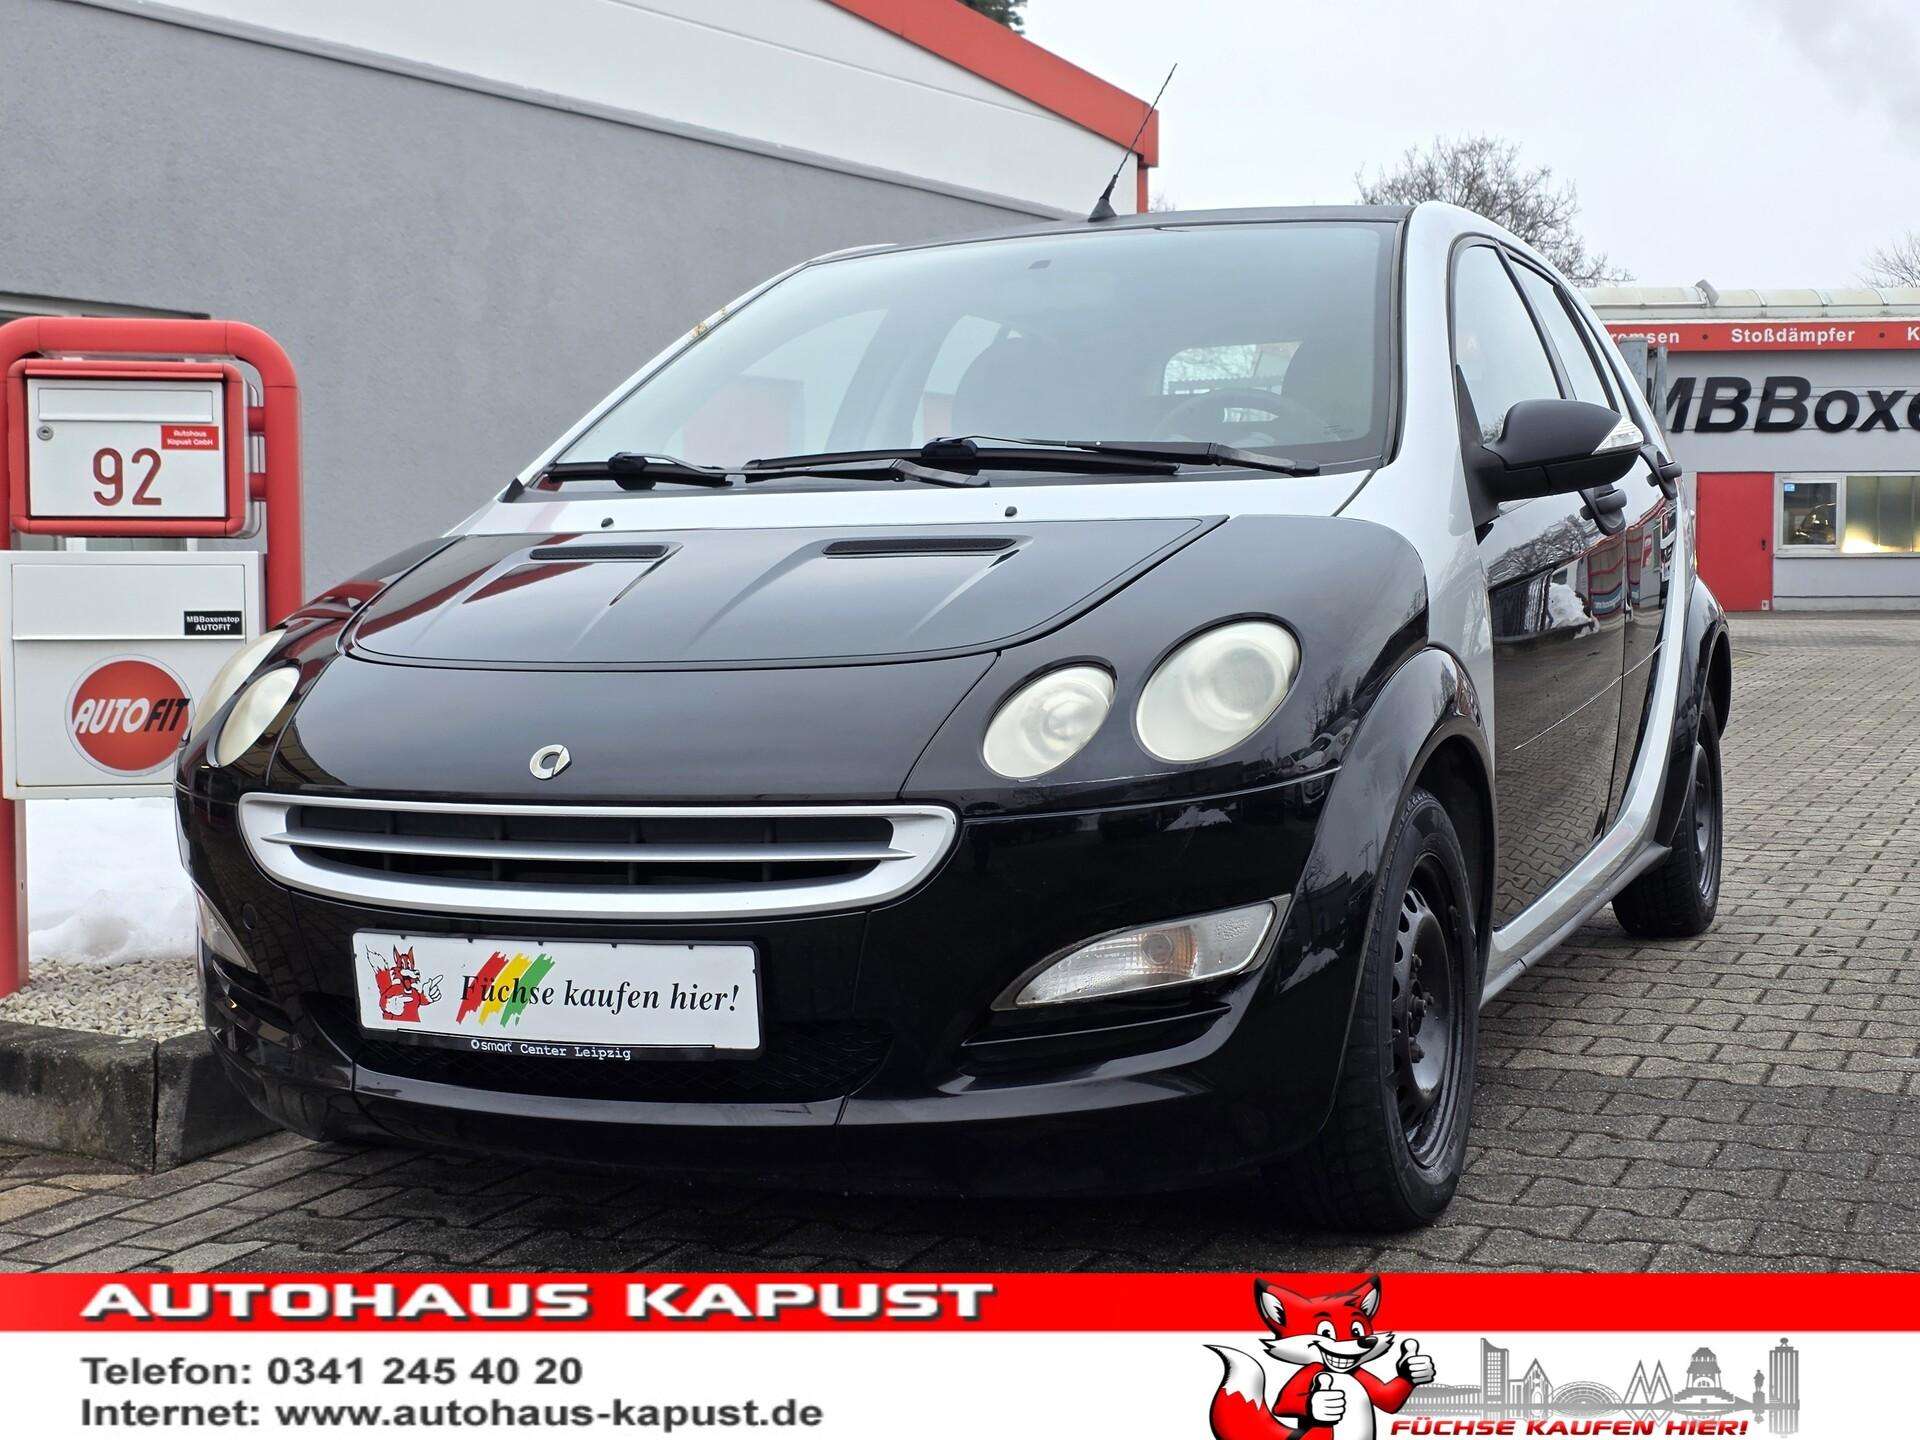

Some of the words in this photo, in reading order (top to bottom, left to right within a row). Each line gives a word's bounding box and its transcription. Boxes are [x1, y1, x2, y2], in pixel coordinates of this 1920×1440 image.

[1731, 327, 1856, 344] Stoßdämpfer
[1646, 376, 1920, 433] MBBox
[173, 430, 208, 438] Autohaus
[92, 447, 162, 506] 92
[186, 615, 240, 624] MBBoxenstop
[195, 623, 231, 631] AUTOFIT
[73, 697, 190, 734] AUTOFIT
[460, 974, 555, 1006] Füchse
[563, 979, 660, 1015] kaufen
[670, 983, 740, 1012] hier!
[480, 1041, 513, 1053] smart
[520, 1043, 567, 1057] Center
[574, 1046, 631, 1061] Leipzig
